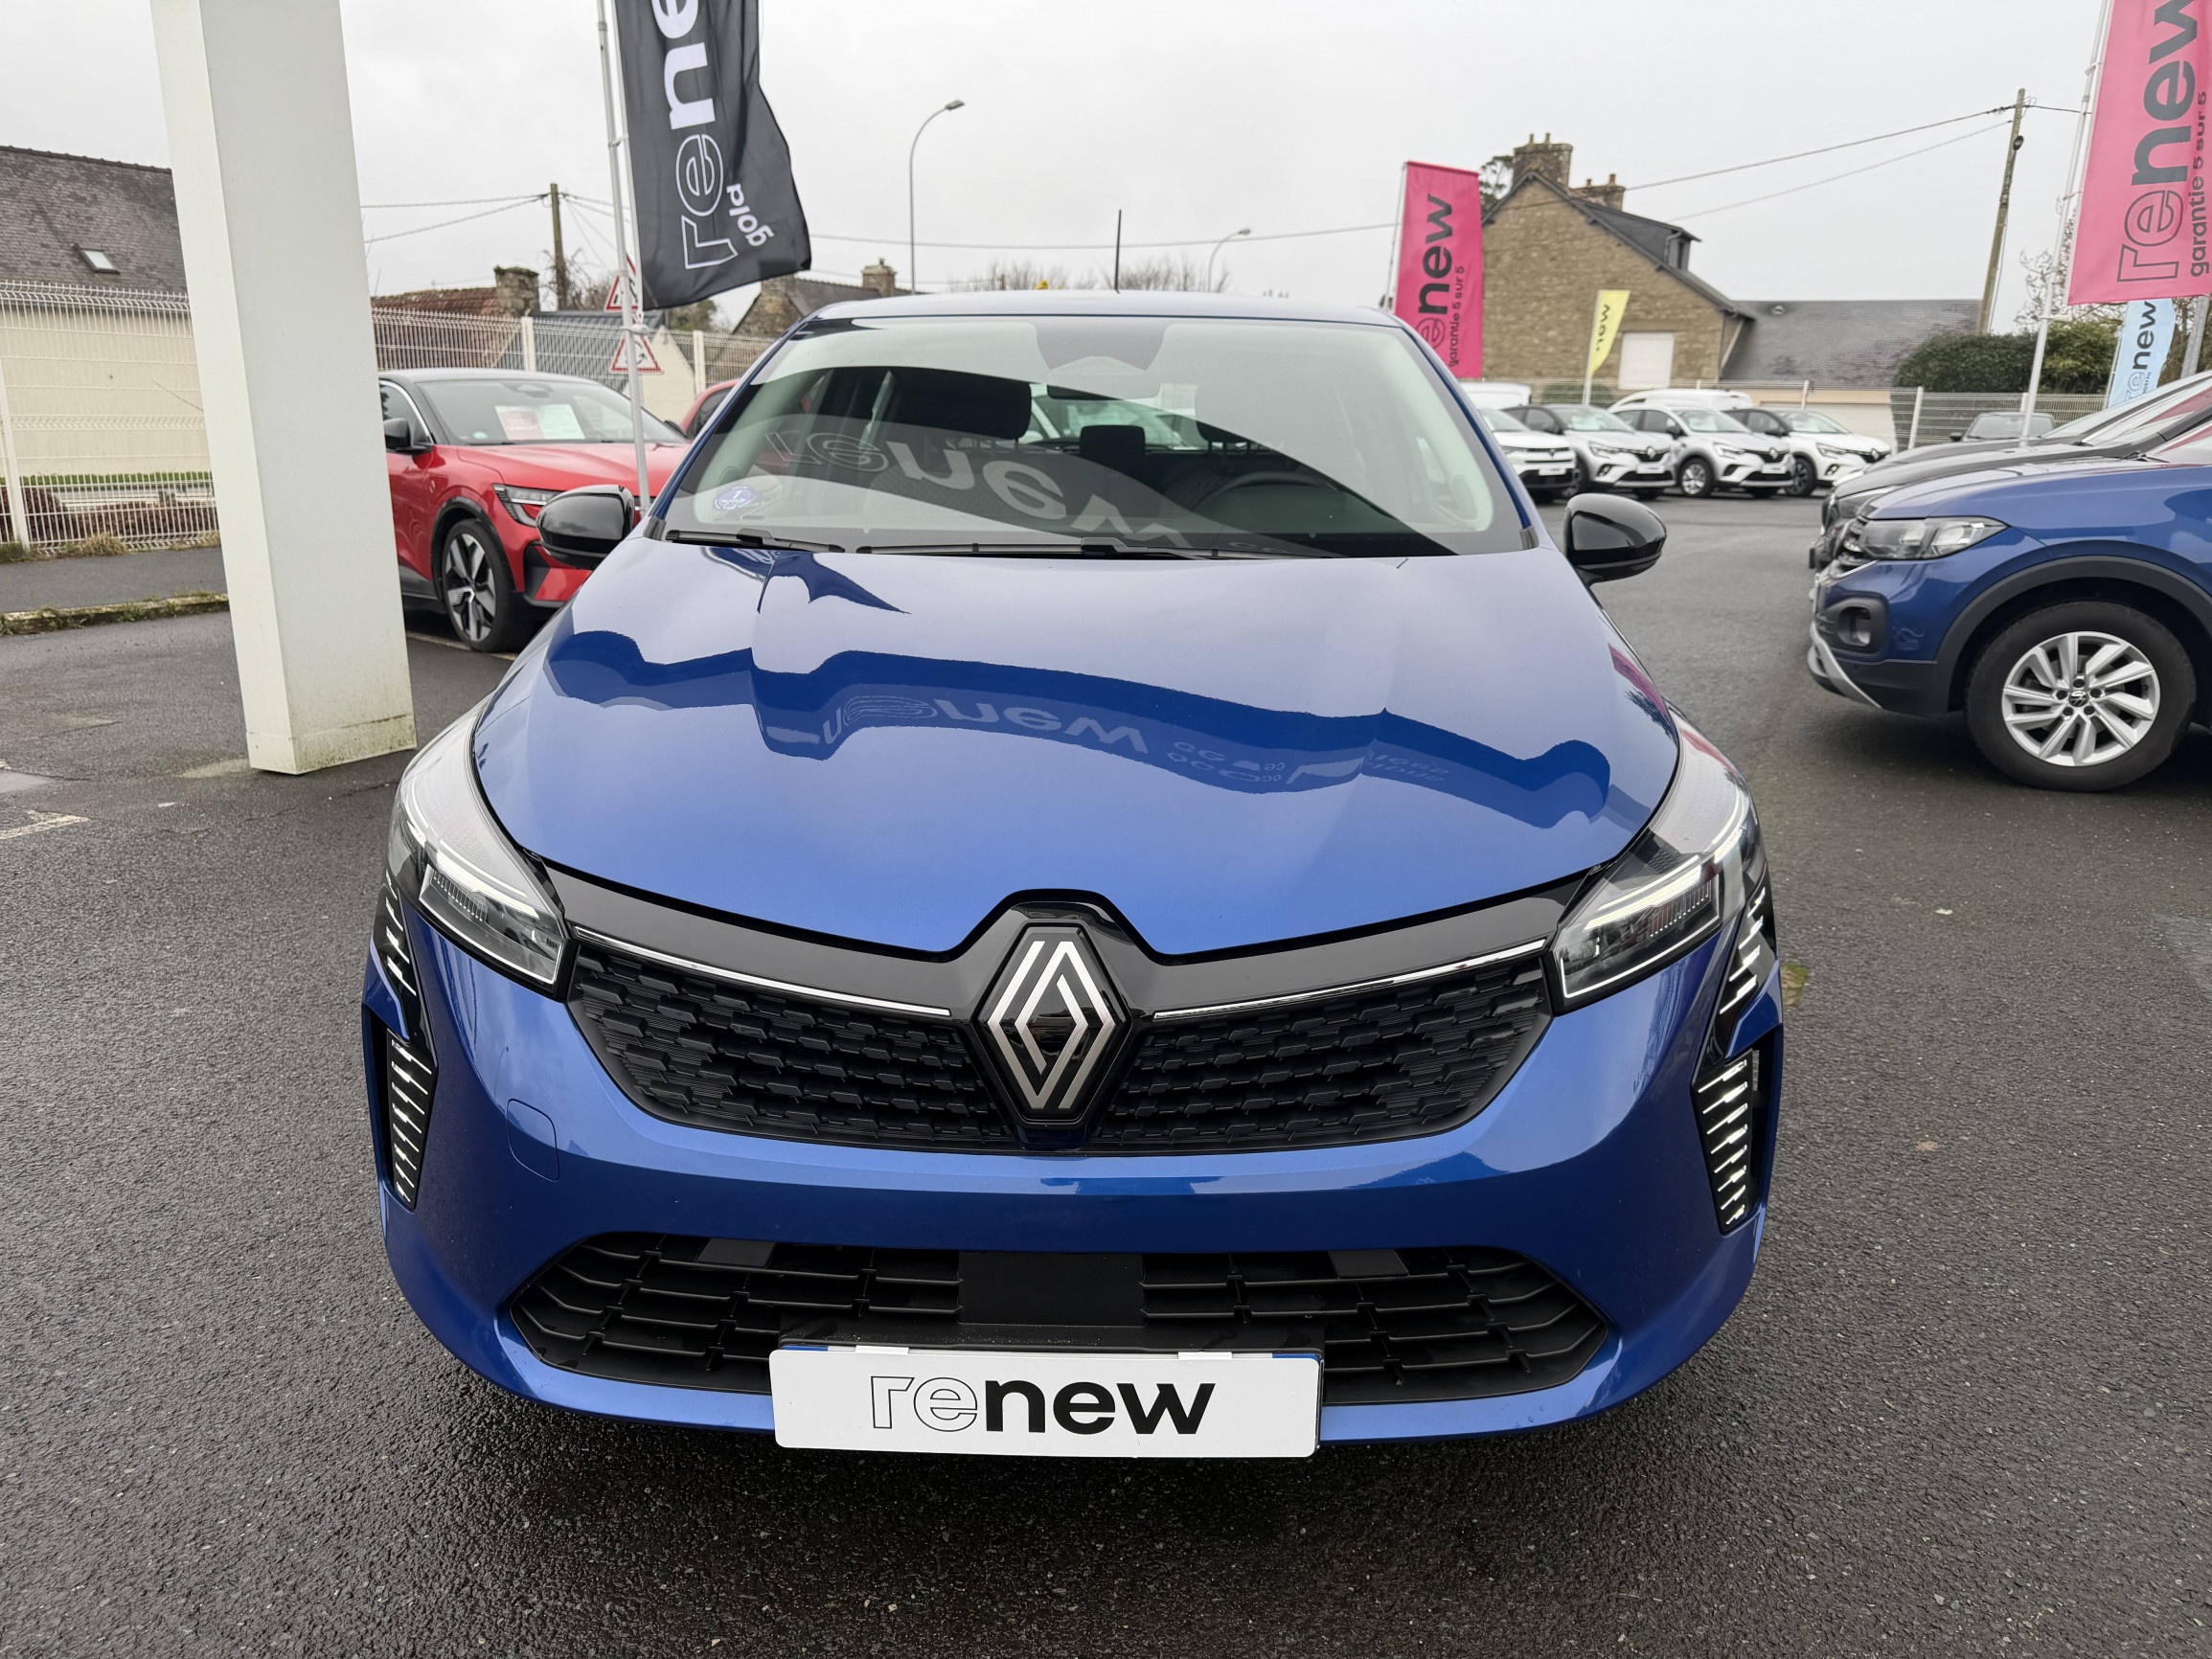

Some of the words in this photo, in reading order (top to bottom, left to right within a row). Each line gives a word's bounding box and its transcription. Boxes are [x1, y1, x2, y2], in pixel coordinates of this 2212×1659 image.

[2117, 0, 2198, 283] renew
[2192, 155, 2204, 170] 5
[2196, 110, 2206, 151] sur
[726, 183, 774, 247] gold
[2189, 176, 2210, 278] garantie
[1416, 193, 1453, 350] enew
[1448, 312, 1460, 367] garantie
[1454, 276, 1464, 299] sur
[870, 1375, 1216, 1435] renew
